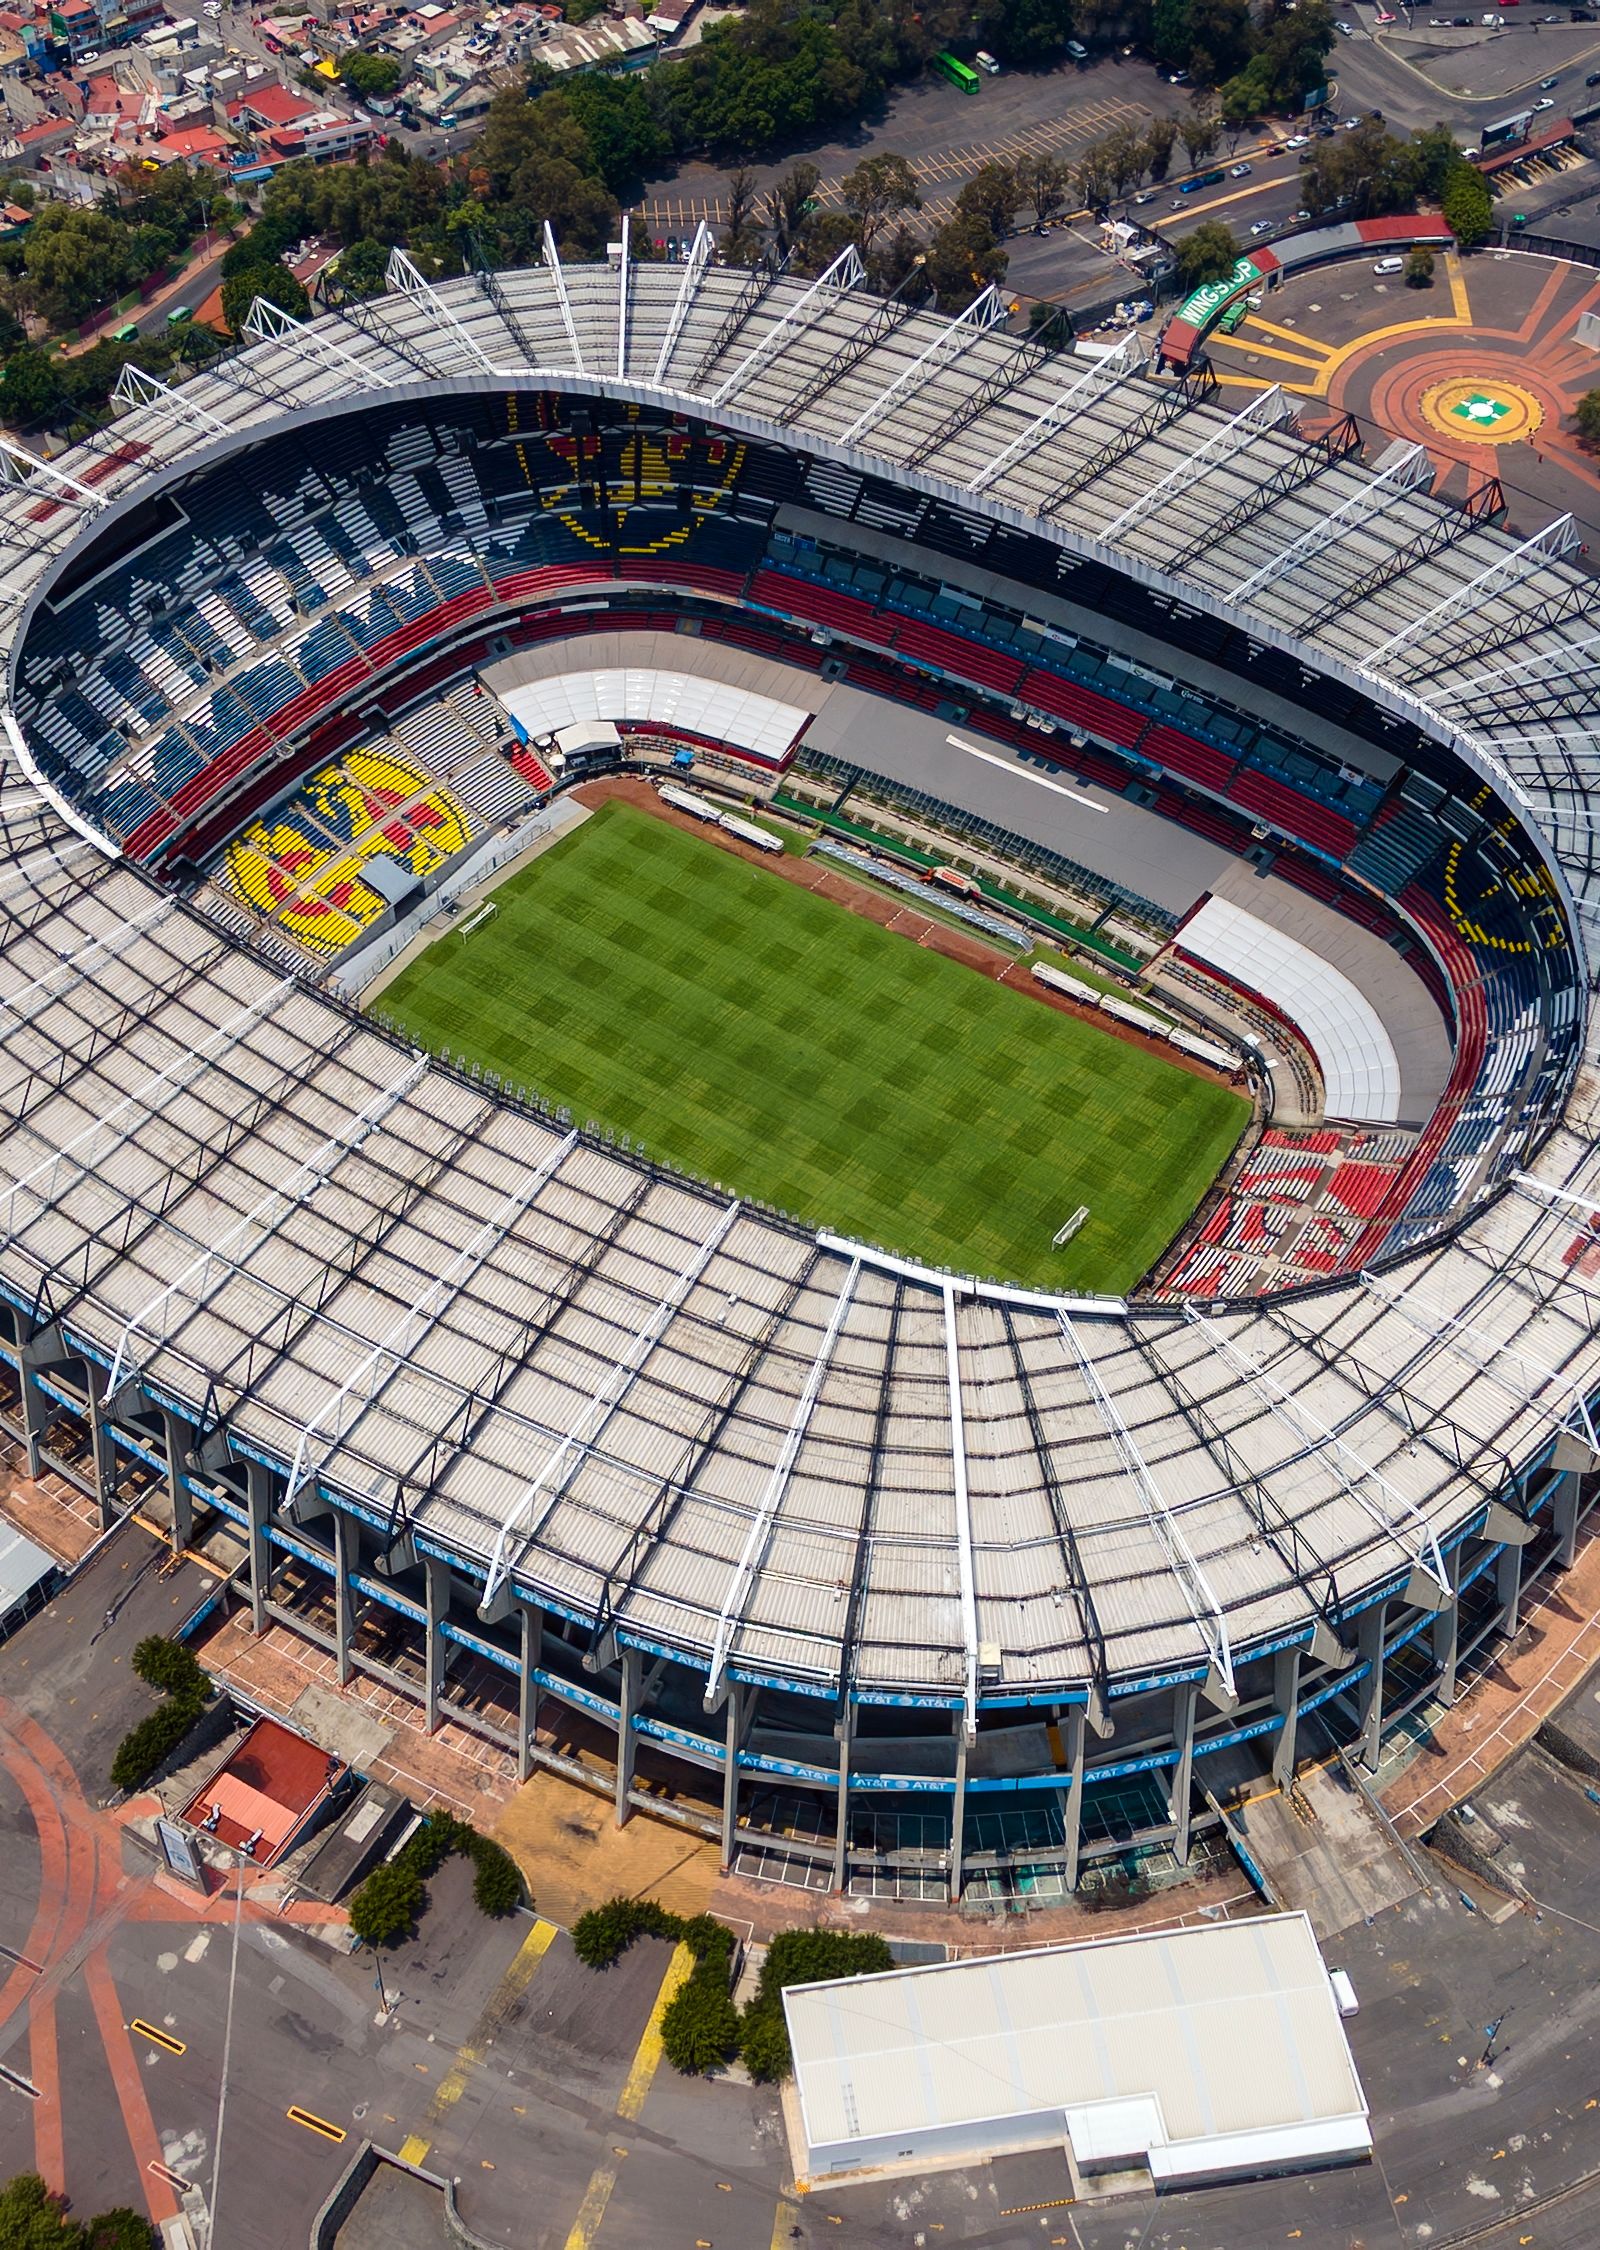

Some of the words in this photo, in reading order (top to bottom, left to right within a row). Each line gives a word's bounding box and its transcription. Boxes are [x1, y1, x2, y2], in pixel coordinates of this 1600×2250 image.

[421, 1542, 448, 1561] AT&T
[521, 1590, 549, 1609] AT&T
[1373, 1581, 1401, 1601] AT&T
[400, 1603, 424, 1623] AT&T
[446, 1628, 472, 1647] AT&T
[491, 1651, 516, 1670] AT&T
[624, 1636, 655, 1653] AT&T
[678, 1652, 711, 1670] AT&T
[1273, 1631, 1303, 1650] AT&T
[735, 1671, 771, 1687] AT&T
[793, 1685, 829, 1699] AT&T
[1108, 1684, 1139, 1697] AT&T
[1163, 1671, 1196, 1685] AT&T
[1336, 1669, 1364, 1691] AT&T
[541, 1676, 569, 1695] AT&T
[587, 1700, 617, 1717] AT&T
[857, 1694, 894, 1705] AT&T
[916, 1698, 954, 1708] AT&T
[640, 1722, 670, 1738] AT&T
[689, 1740, 721, 1757] AT&T
[1193, 1740, 1224, 1755] AT&T
[1245, 1721, 1276, 1737] AT&T
[743, 1757, 776, 1770] AT&T
[797, 1768, 831, 1782] AT&T
[1085, 1767, 1117, 1782] AT&T
[1140, 1756, 1171, 1770] AT&T
[856, 1779, 890, 1789] AT&T
[912, 1781, 948, 1790] AT&T
